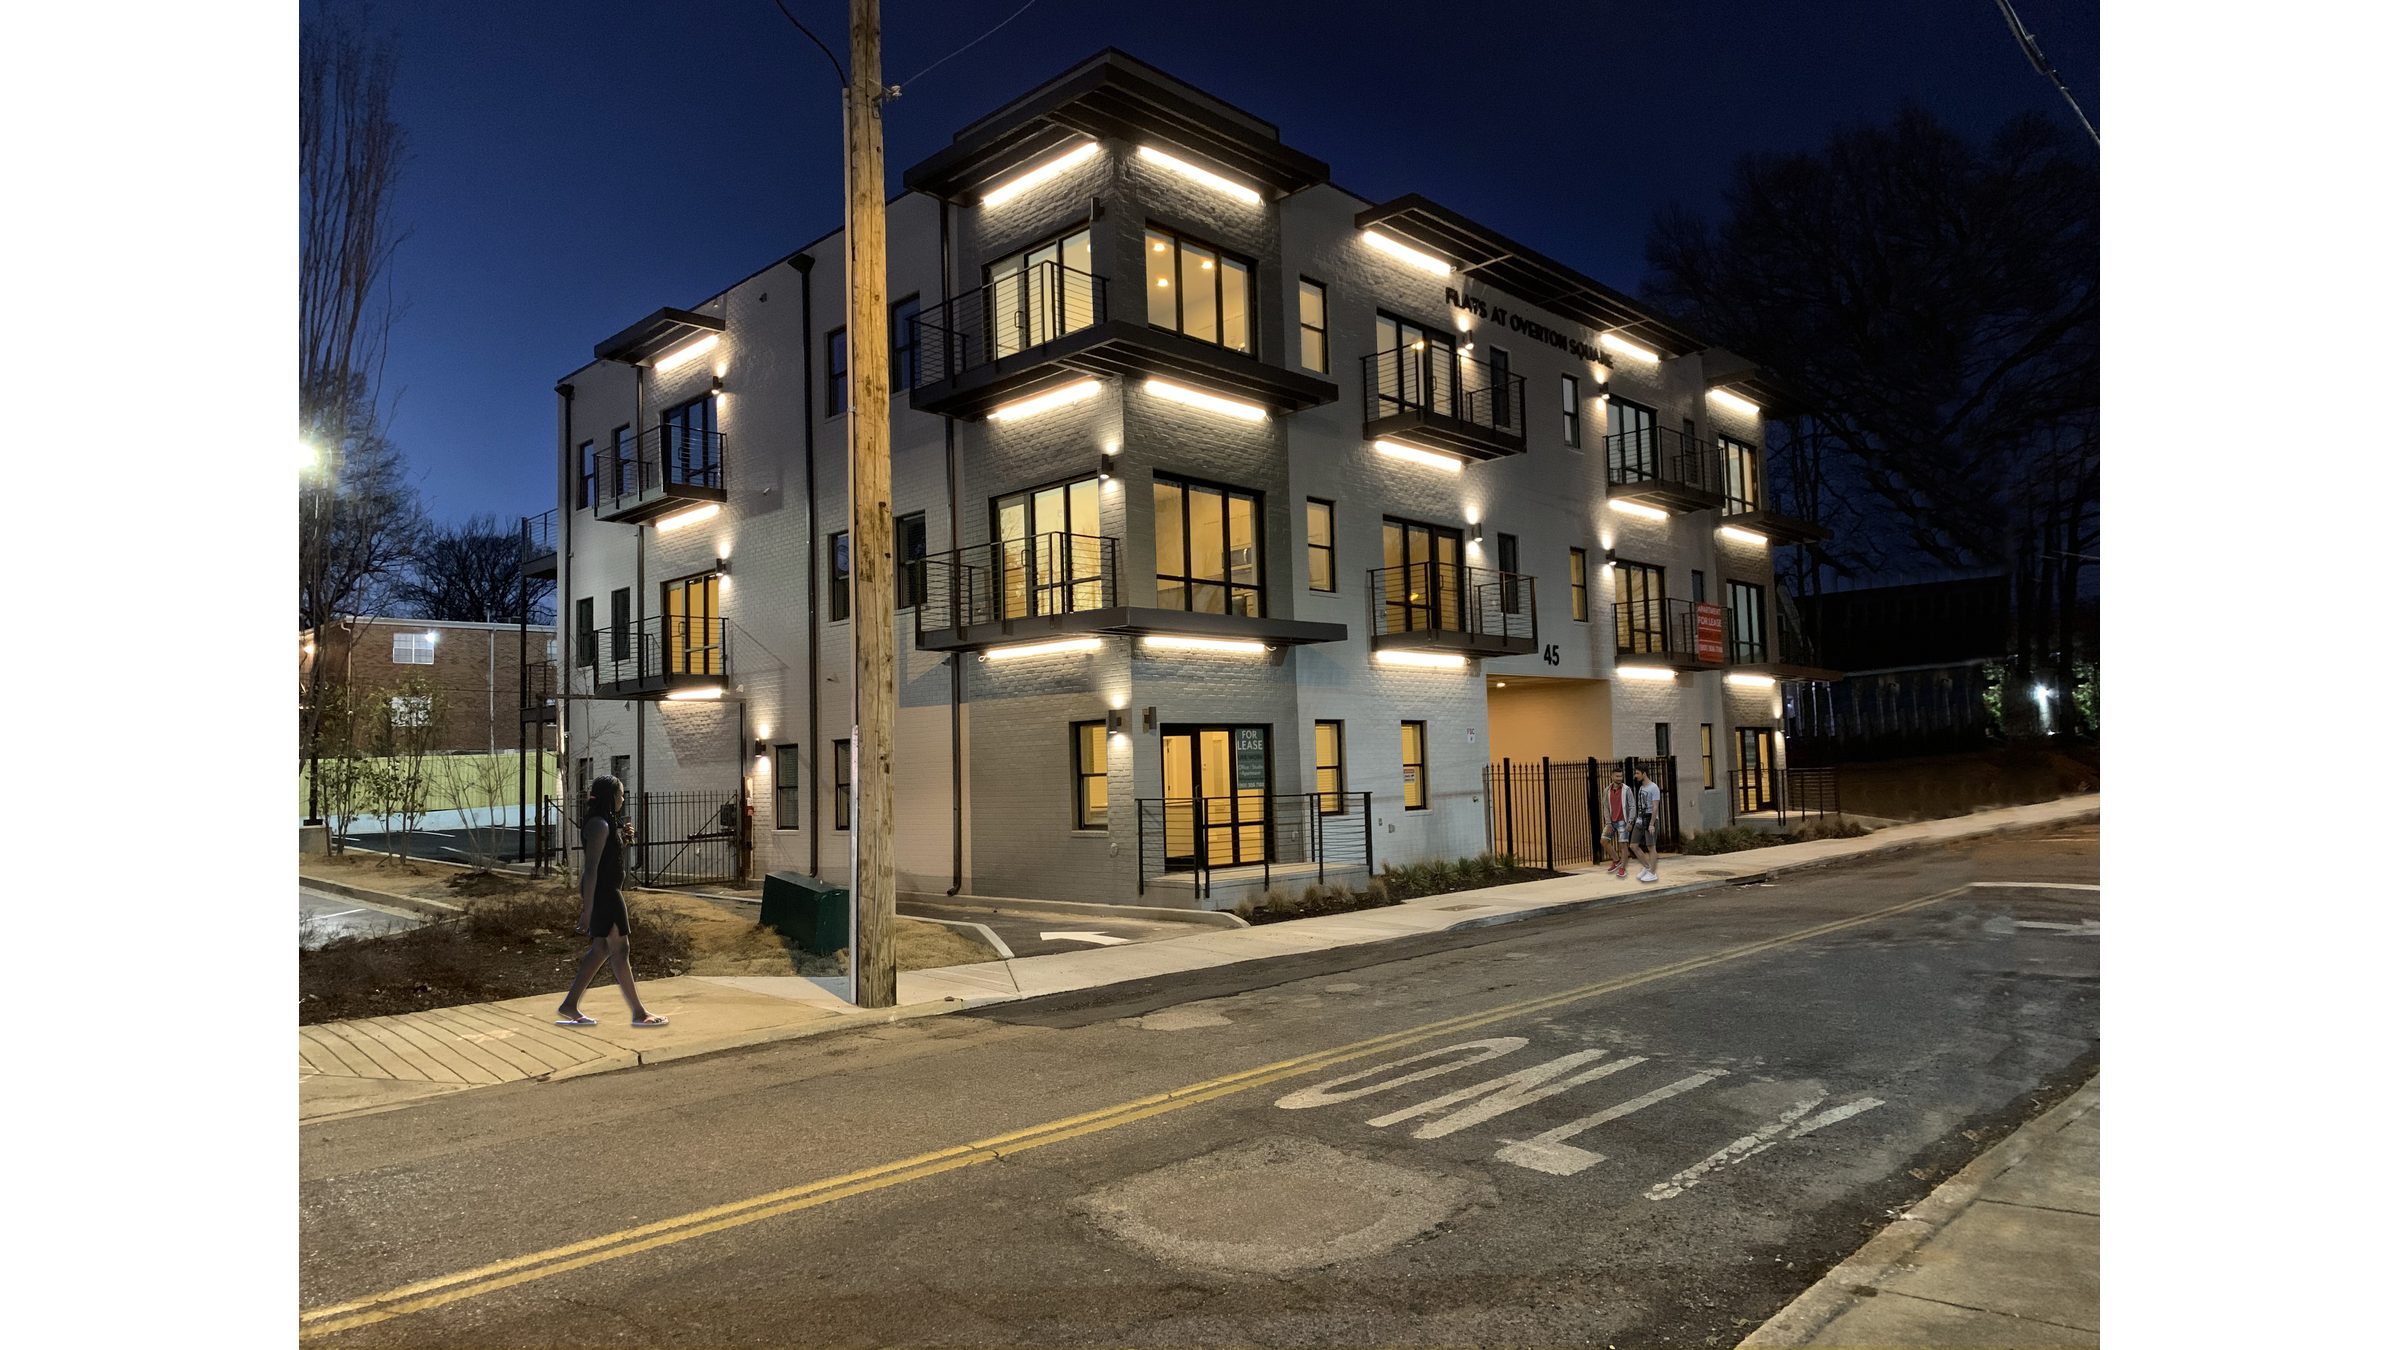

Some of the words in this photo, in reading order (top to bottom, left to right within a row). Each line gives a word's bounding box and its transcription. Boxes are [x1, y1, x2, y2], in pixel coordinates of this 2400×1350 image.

[1446, 287, 1487, 318] FLATS
[1491, 306, 1507, 327] AT
[1509, 314, 1567, 351] OVERTON
[1569, 339, 1614, 369] SQUARE
[1698, 616, 1708, 625] FOR
[1543, 644, 1560, 666] 45
[1241, 730, 1257, 739] FOR
[1237, 740, 1263, 750] LEASE
[1275, 1036, 1886, 1200] ONLY
